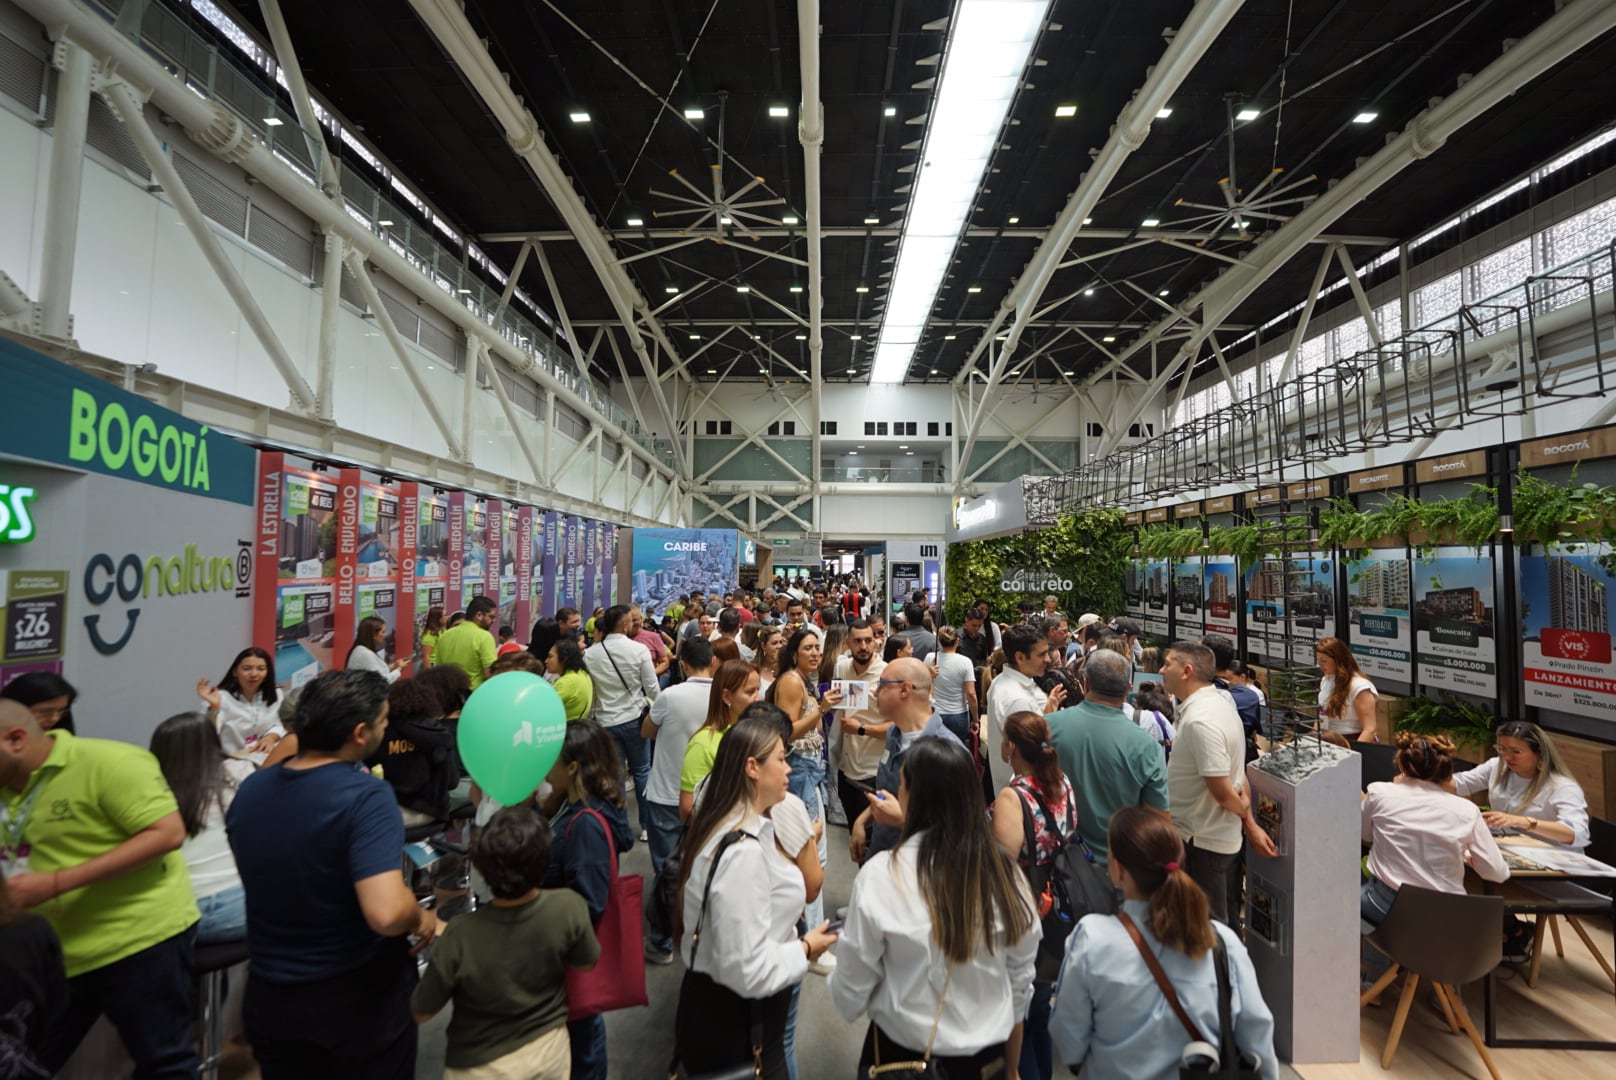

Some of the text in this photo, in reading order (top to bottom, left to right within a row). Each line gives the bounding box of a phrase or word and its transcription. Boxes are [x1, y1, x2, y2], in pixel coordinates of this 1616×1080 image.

[69, 387, 211, 492] BOGOTÁ
[1544, 439, 1590, 456] BOGOTÁ
[1432, 459, 1467, 473] BOGOTÁ
[261, 471, 280, 555] LA ESTRELLA
[403, 496, 417, 549] MEDELLÍN
[451, 504, 463, 551] MEDELLÍN
[663, 541, 708, 552] CARIBE
[339, 565, 354, 605] BELLO
[402, 559, 415, 593] BELLO
[450, 559, 462, 591] BELLO
[489, 548, 500, 591] MEDELLÍN
[1564, 641, 1584, 652] VIS
[1554, 661, 1604, 674] Prado Pinzón
